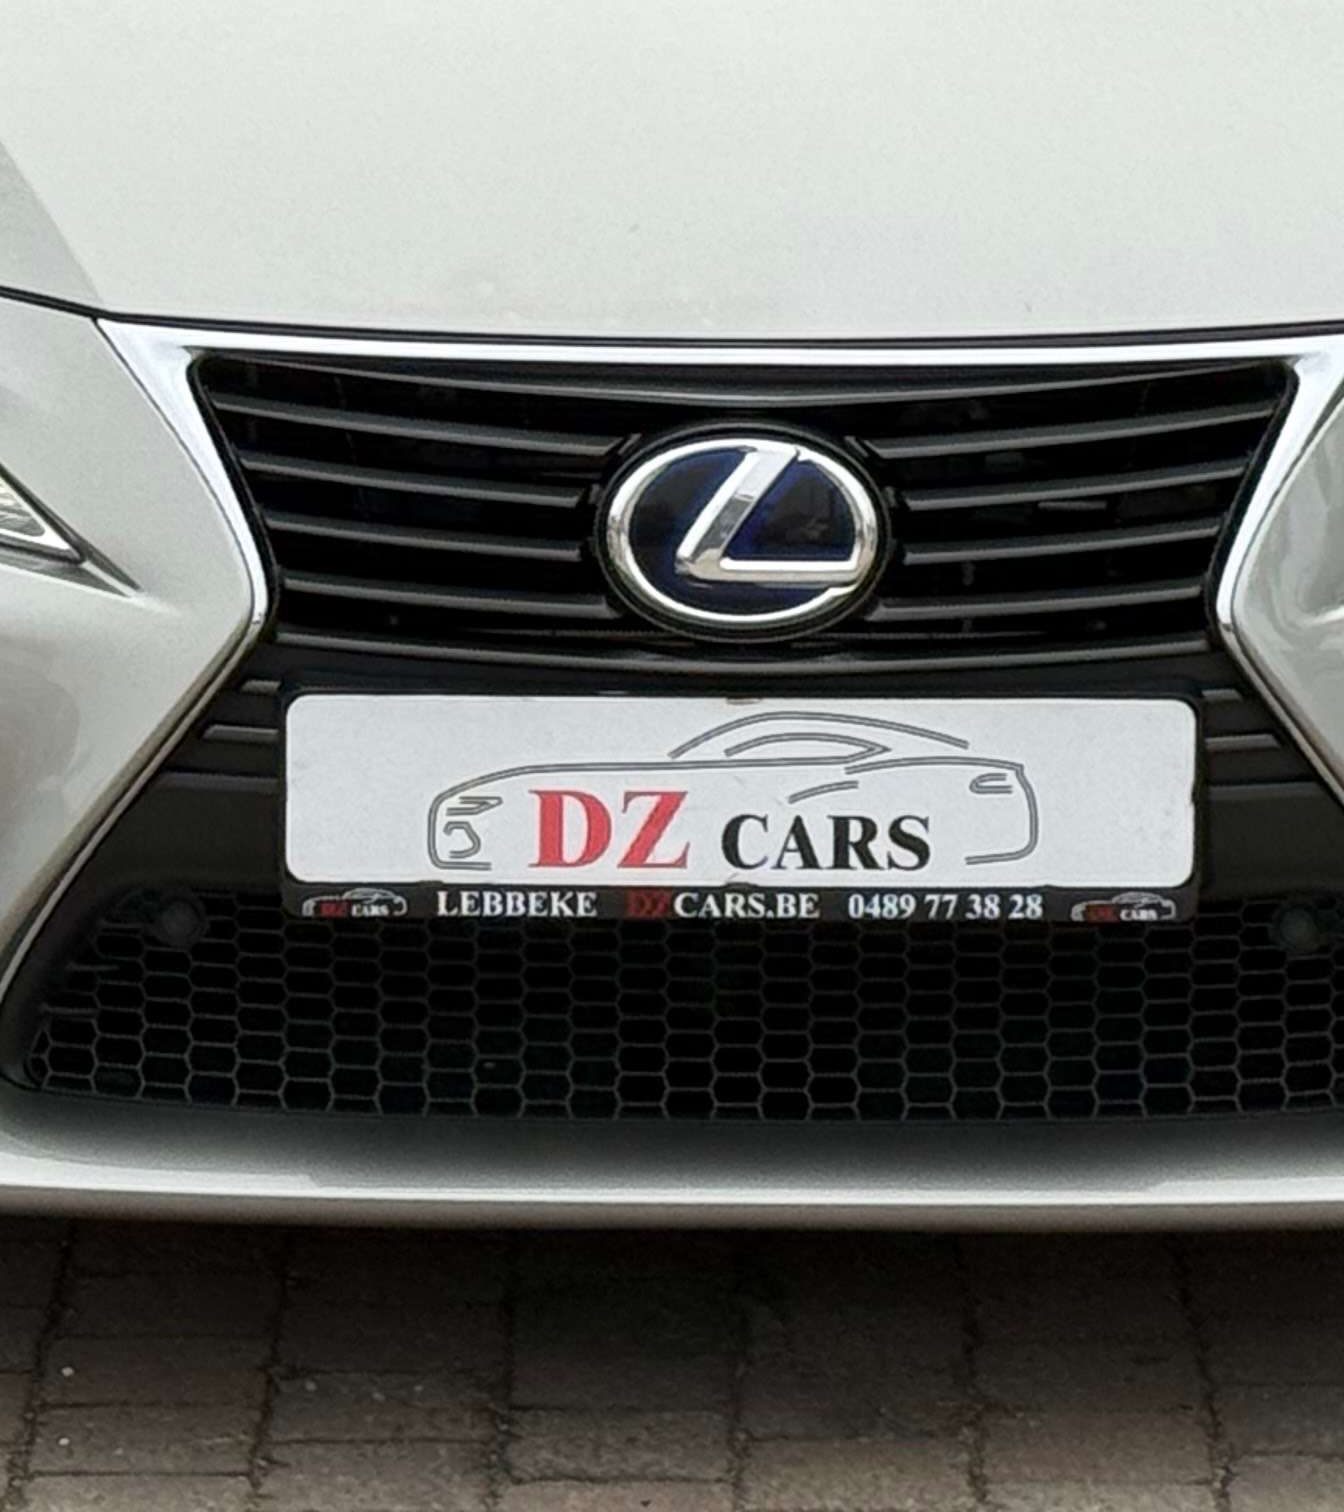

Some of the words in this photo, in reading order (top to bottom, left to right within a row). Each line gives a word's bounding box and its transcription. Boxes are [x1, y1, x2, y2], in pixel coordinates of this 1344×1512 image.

[528, 789, 689, 870] DZ
[722, 814, 931, 872] CARS
[436, 891, 598, 918] LEBBEKE
[848, 893, 916, 919] 0489
[923, 894, 958, 919] 77
[965, 894, 1001, 919] 38
[1008, 894, 1044, 919] 28
